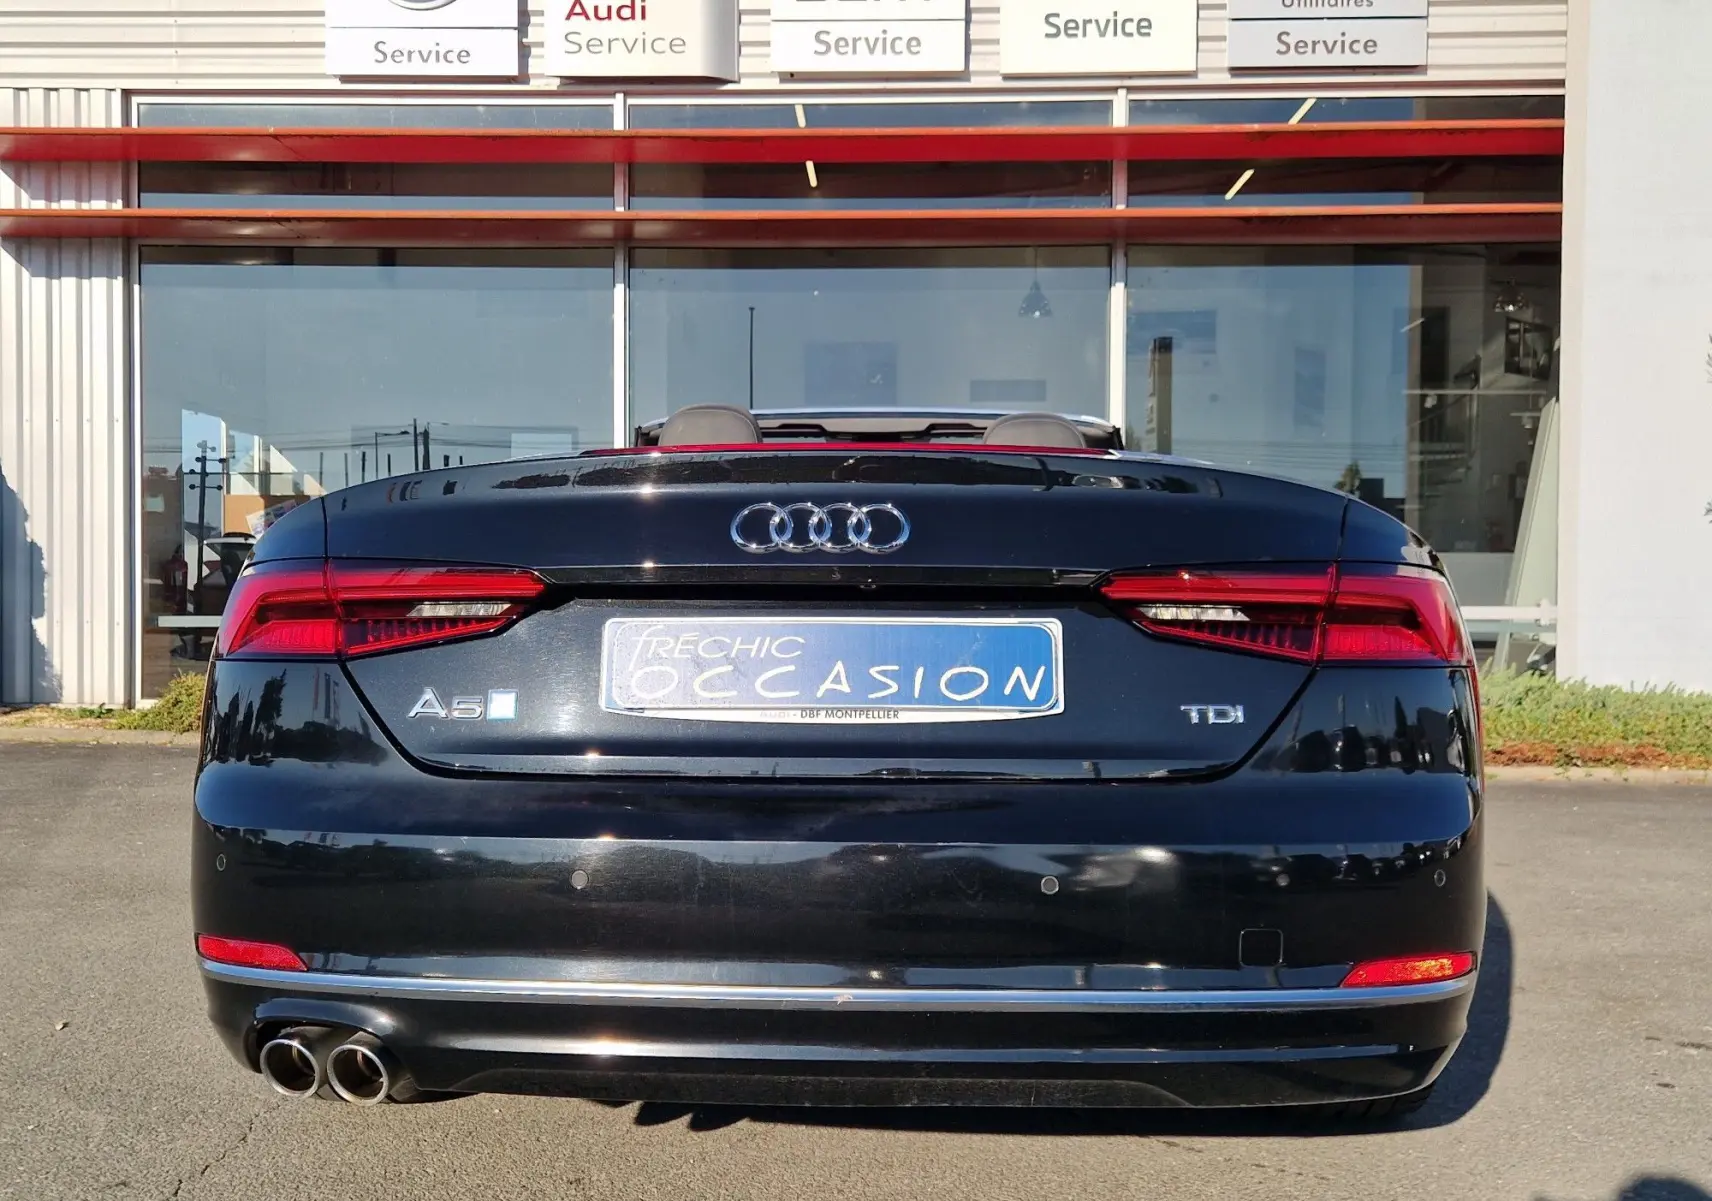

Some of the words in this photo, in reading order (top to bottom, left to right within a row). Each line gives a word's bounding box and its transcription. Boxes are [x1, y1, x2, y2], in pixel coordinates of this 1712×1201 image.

[565, 0, 647, 21] Audi
[1044, 11, 1153, 38] Service
[373, 40, 471, 64] Service
[564, 31, 687, 54] Service
[813, 29, 922, 56] Service
[1275, 31, 1378, 55] Service
[631, 660, 1046, 701] OCCASION
[406, 686, 484, 720] A5
[800, 709, 821, 719] DBF
[824, 709, 900, 719] MONTPELLIER
[1180, 704, 1245, 724] TDI
